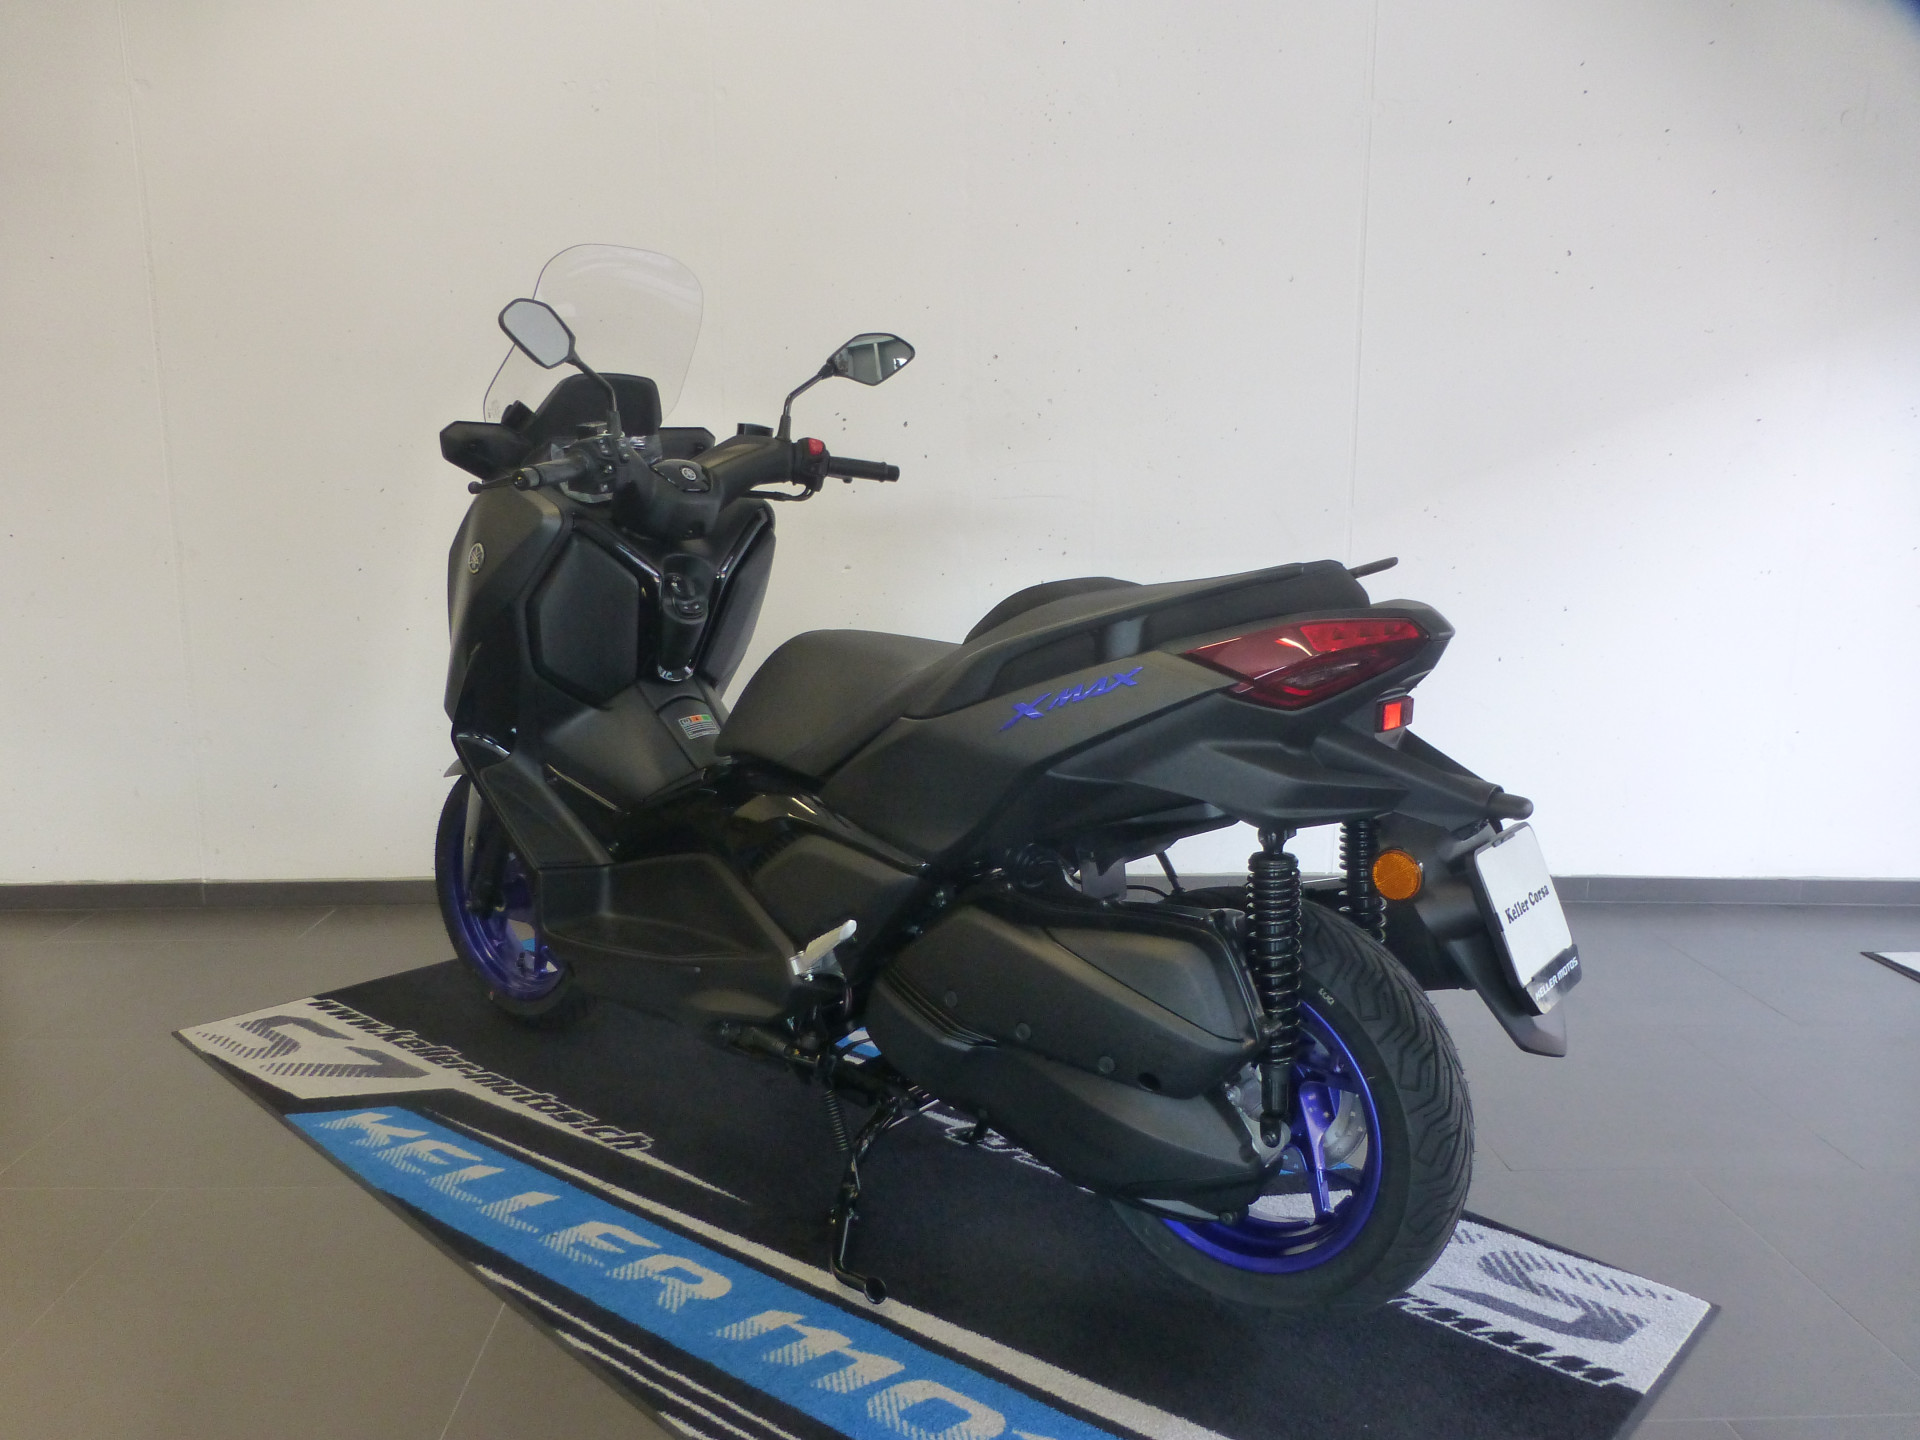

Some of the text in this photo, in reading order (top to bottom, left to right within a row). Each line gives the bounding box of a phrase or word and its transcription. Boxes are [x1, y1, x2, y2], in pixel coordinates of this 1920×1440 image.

[1504, 885, 1550, 924] Keller Corsa
[1535, 956, 1579, 1001] KELLER MOTOS
[315, 1112, 732, 1314] KELLER
